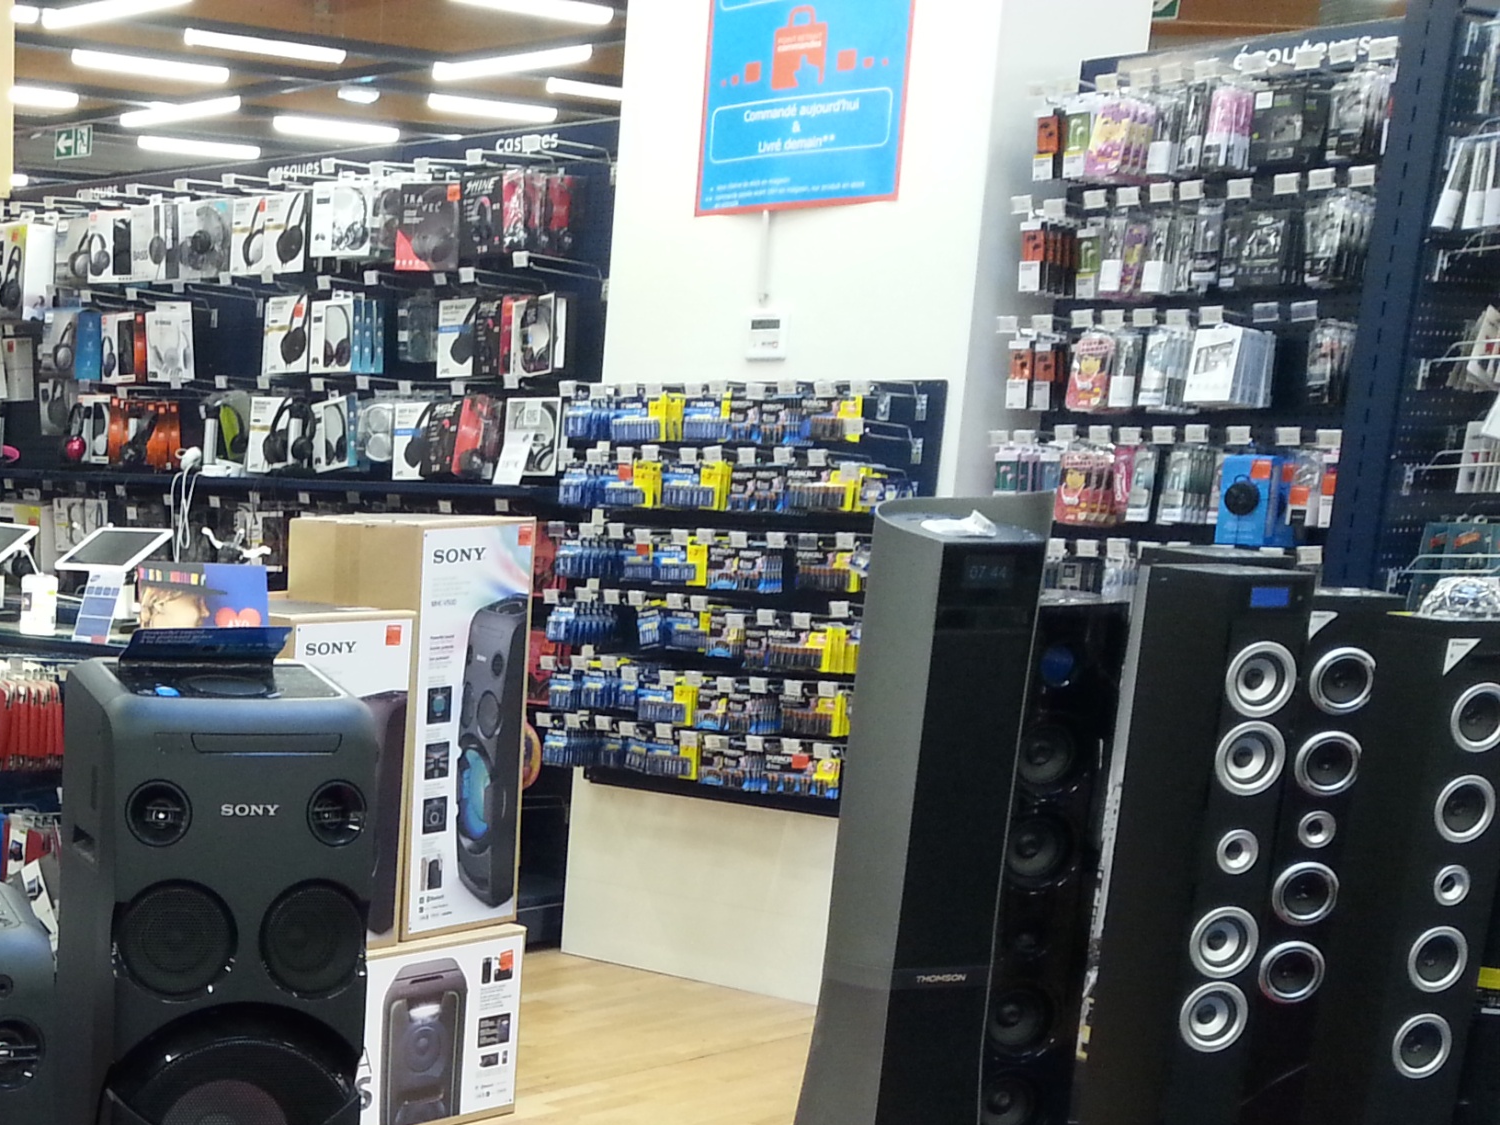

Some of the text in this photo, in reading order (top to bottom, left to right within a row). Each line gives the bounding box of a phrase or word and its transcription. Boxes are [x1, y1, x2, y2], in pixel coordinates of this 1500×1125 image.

[495, 132, 558, 152] cases
[433, 547, 487, 564] SONY
[305, 641, 357, 656] SONY
[220, 803, 280, 818] SONY
[916, 973, 967, 983] THOMSON
